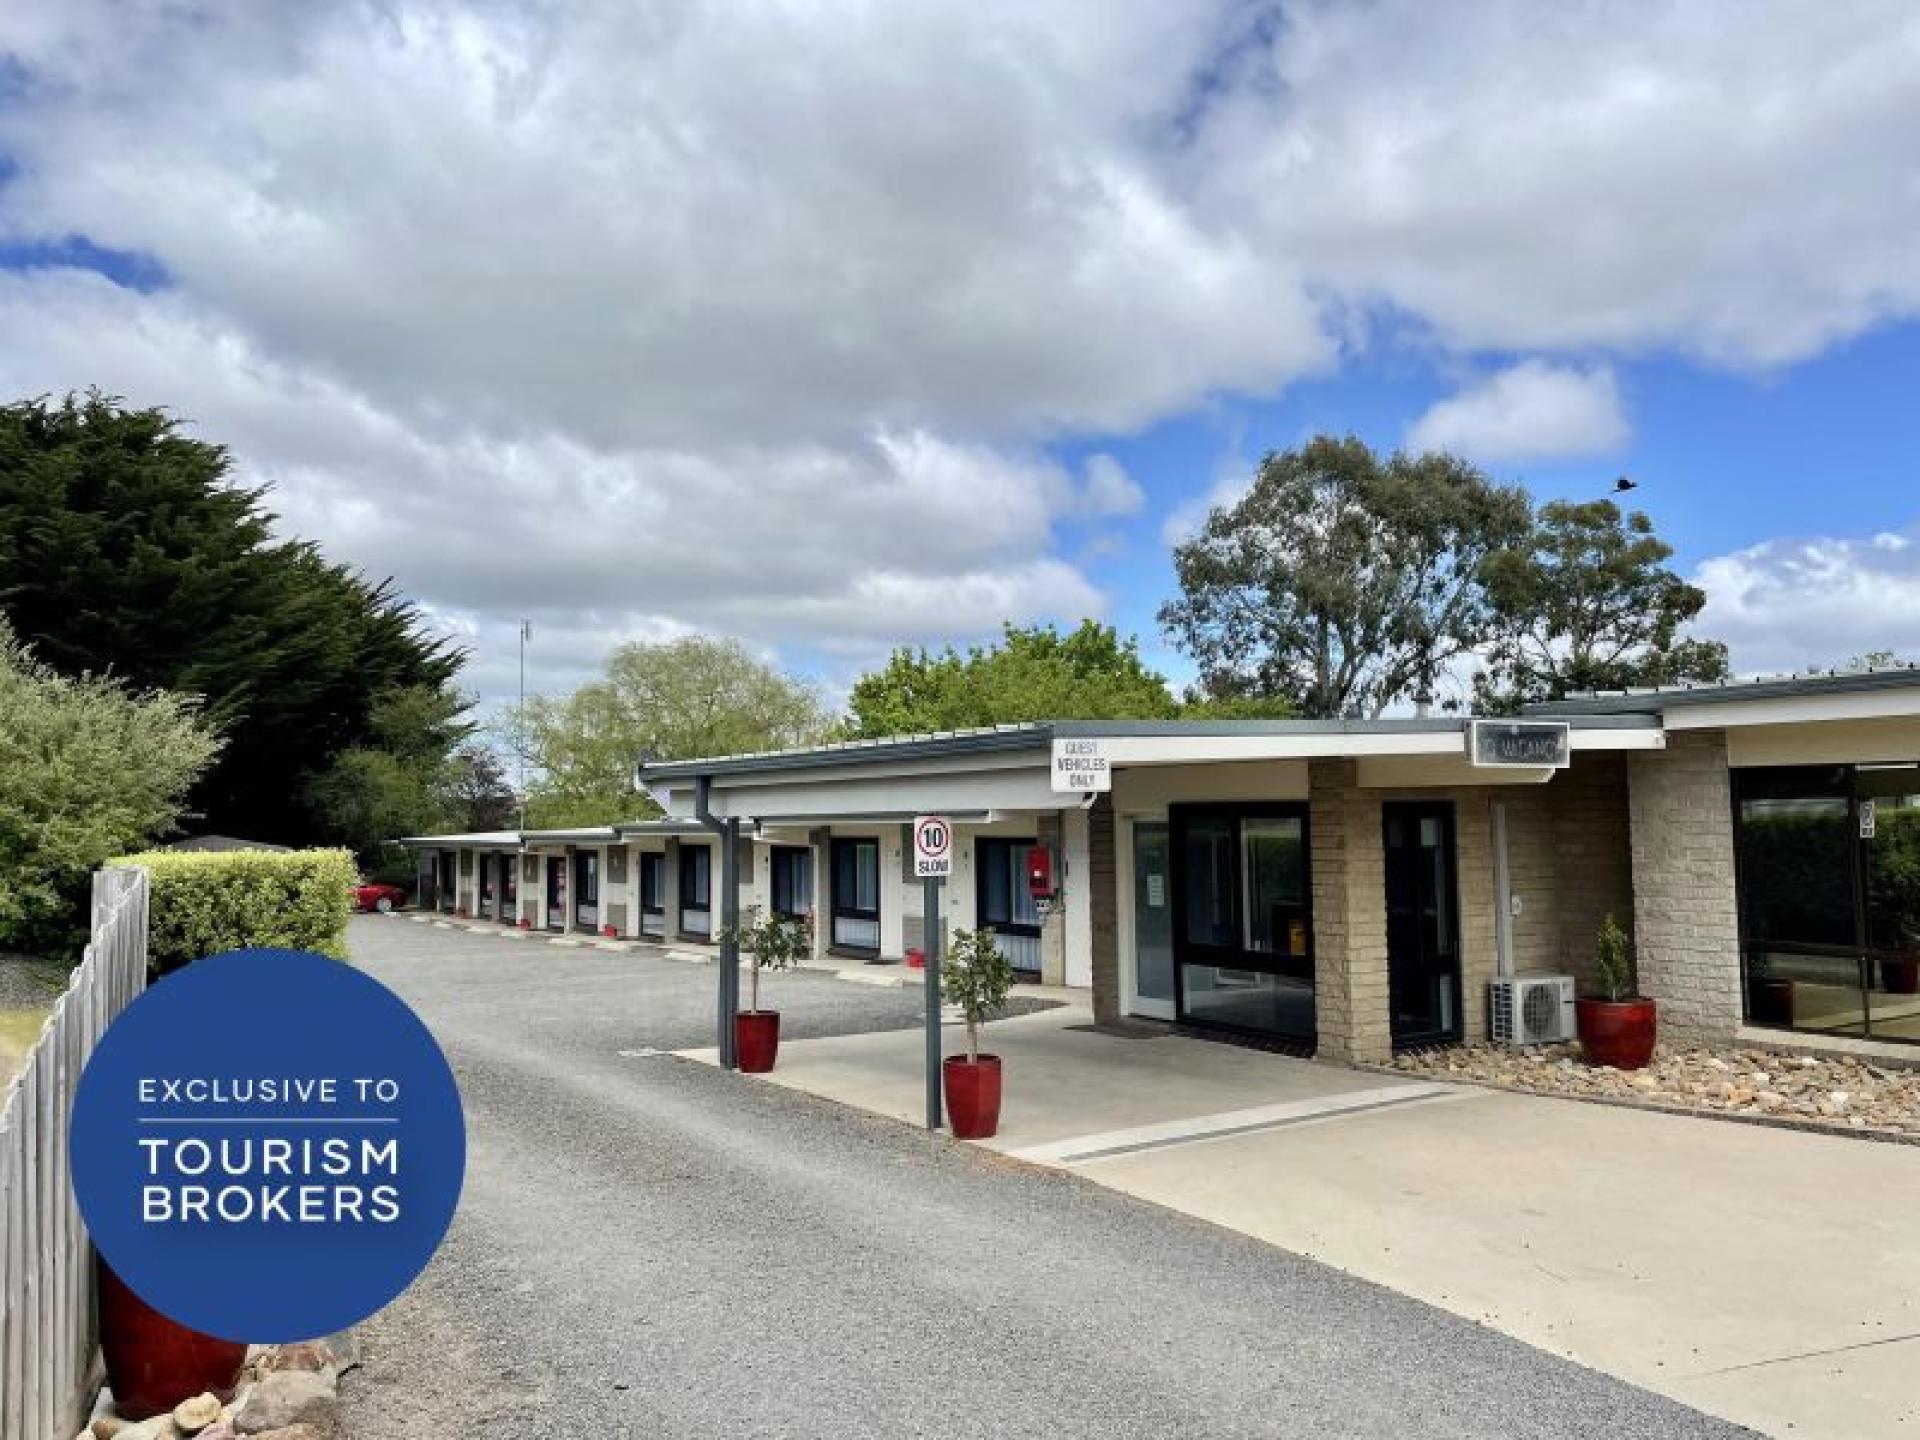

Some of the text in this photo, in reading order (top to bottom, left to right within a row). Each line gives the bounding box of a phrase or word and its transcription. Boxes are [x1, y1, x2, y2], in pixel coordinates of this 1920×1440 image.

[1058, 758, 1105, 771] VEHICLES
[1070, 774, 1095, 787] ONLY
[924, 827, 943, 847] 10
[919, 860, 949, 873] SLOW
